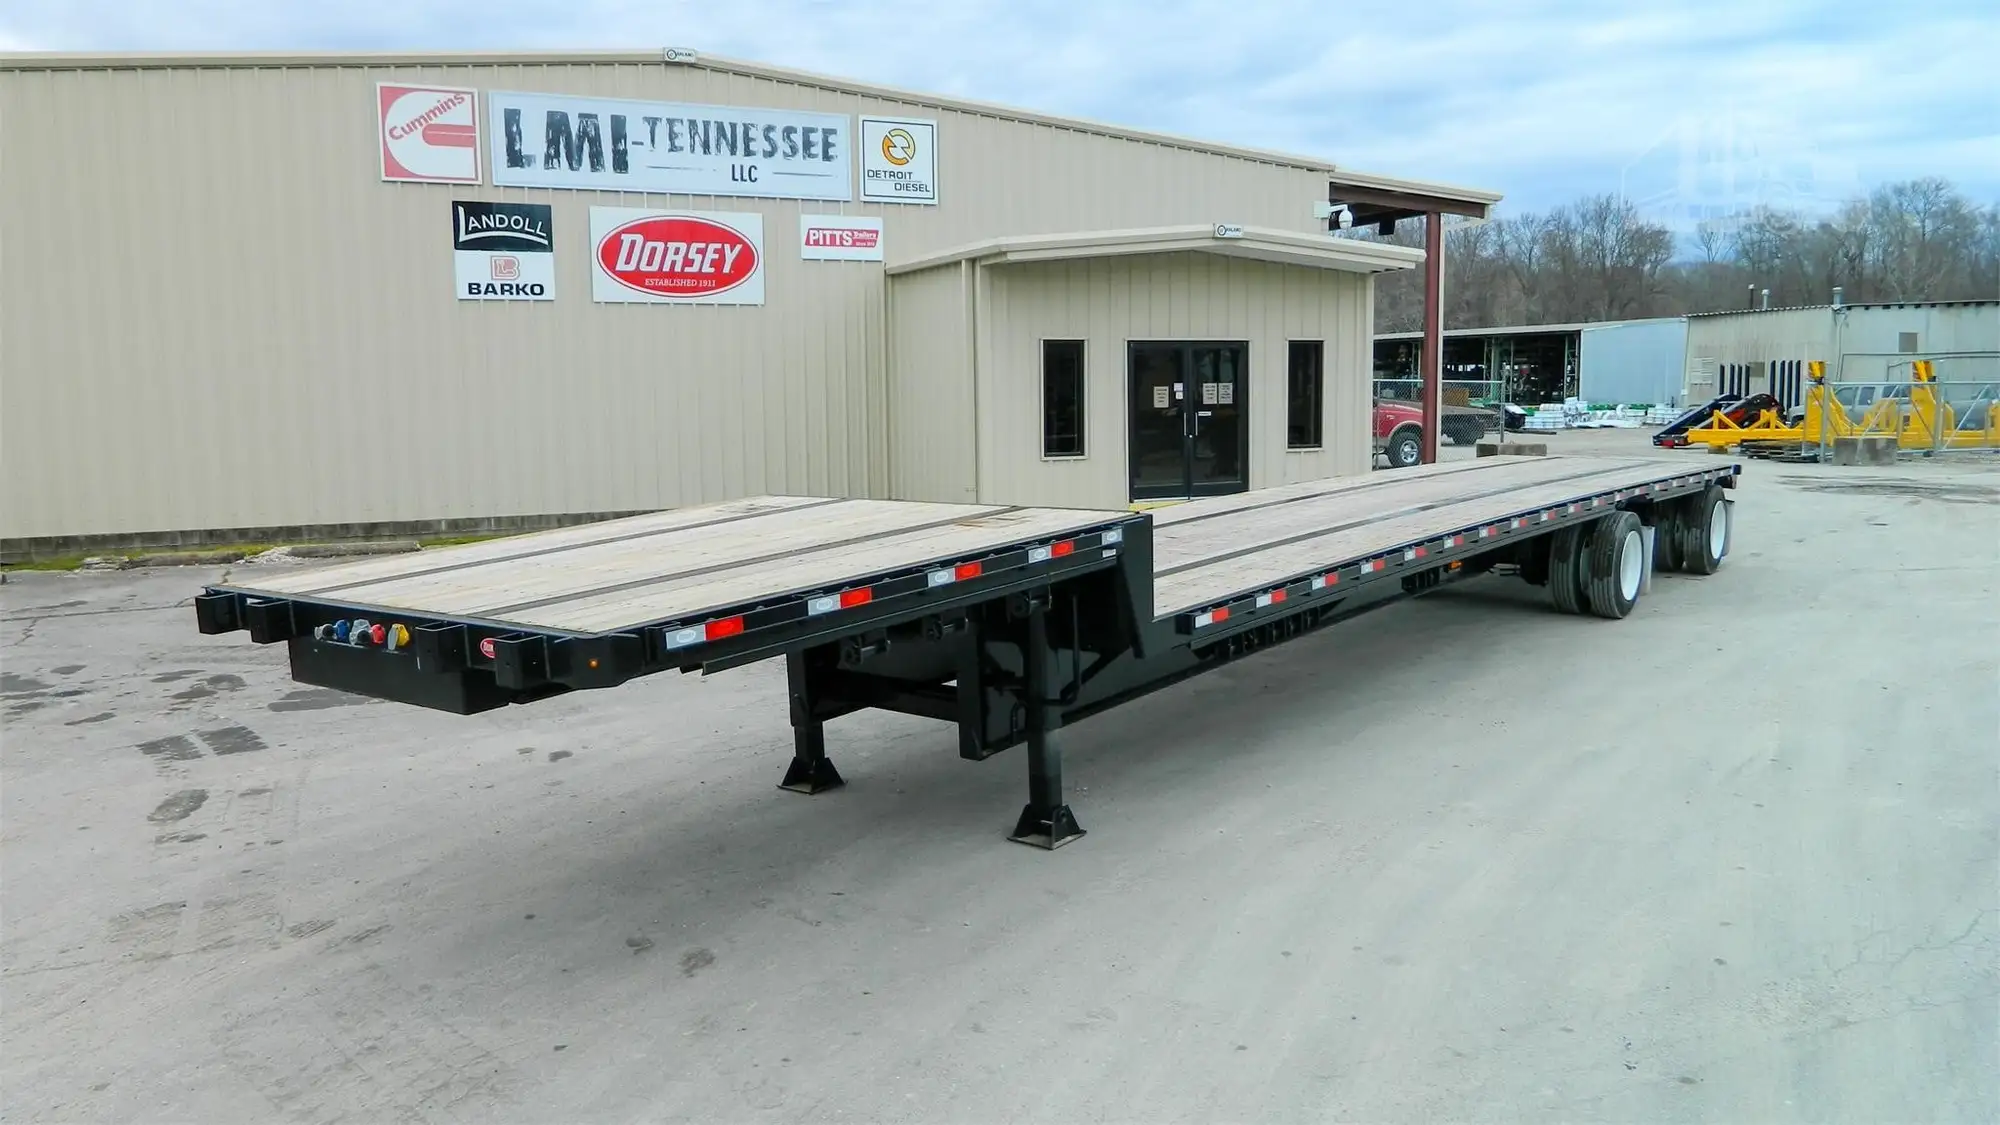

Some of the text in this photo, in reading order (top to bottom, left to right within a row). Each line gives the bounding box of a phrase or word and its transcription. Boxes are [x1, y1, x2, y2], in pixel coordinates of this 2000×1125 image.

[389, 93, 465, 140] Cummins
[731, 163, 758, 183] LLC
[867, 169, 913, 180] DETROIT
[894, 182, 930, 193] DIESEL
[458, 205, 548, 244] LANDOLL
[615, 233, 743, 274] DORSEY
[468, 282, 545, 296] BARKO
[645, 278, 716, 288] ESTABLISHED 1911
